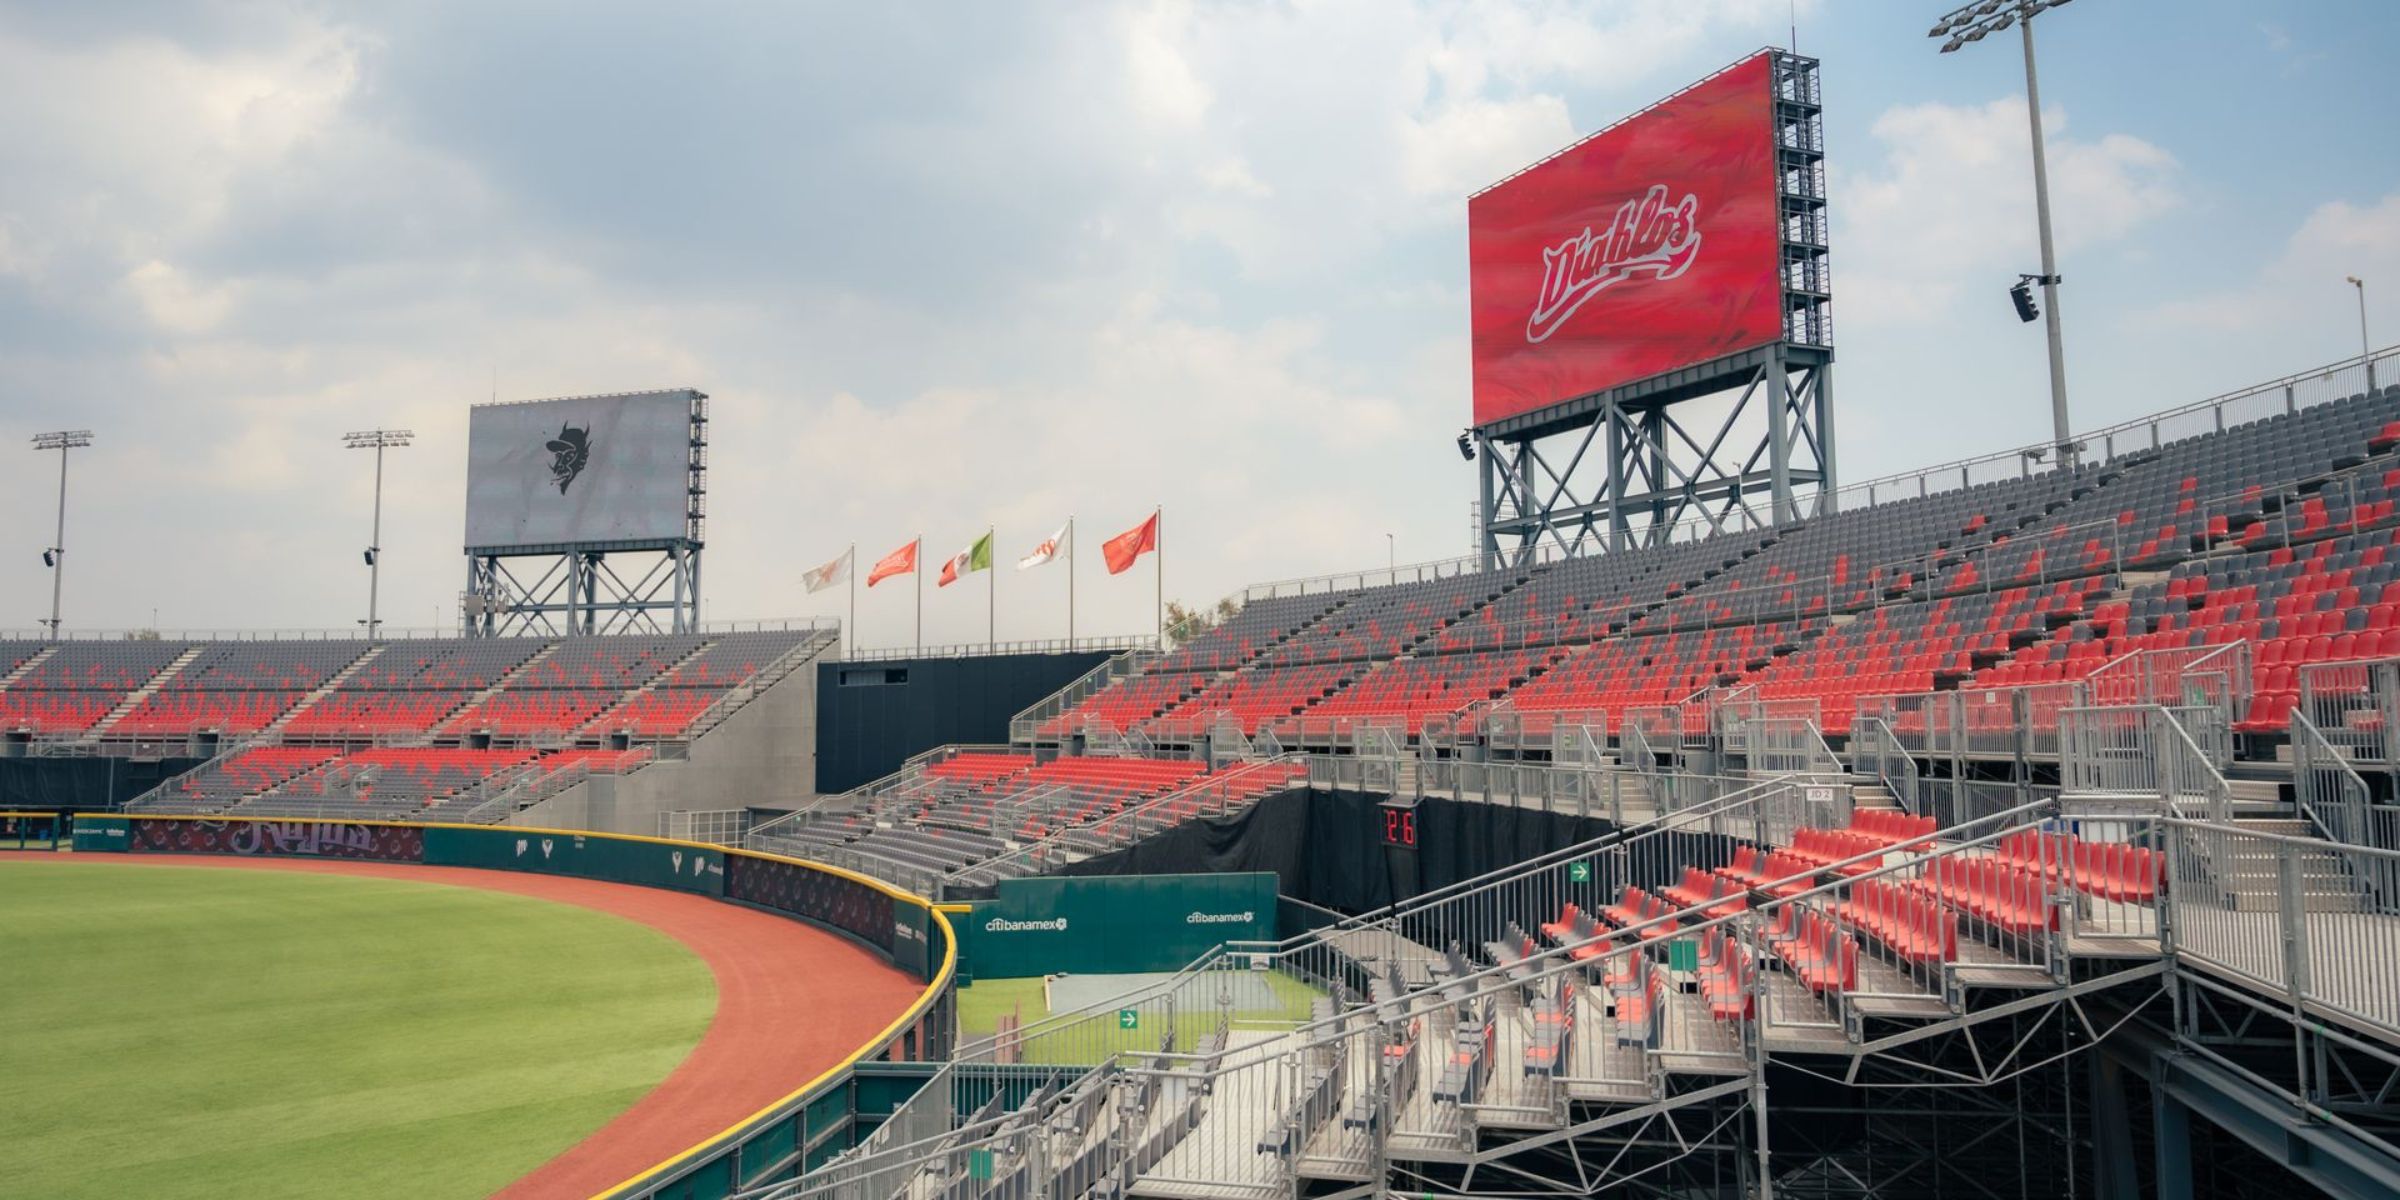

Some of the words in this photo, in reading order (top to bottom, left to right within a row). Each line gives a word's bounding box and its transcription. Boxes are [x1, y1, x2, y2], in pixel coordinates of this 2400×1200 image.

[1531, 184, 1699, 334] Diablos
[1186, 911, 1242, 923] citibanamex
[985, 918, 1056, 931] citibanamex
